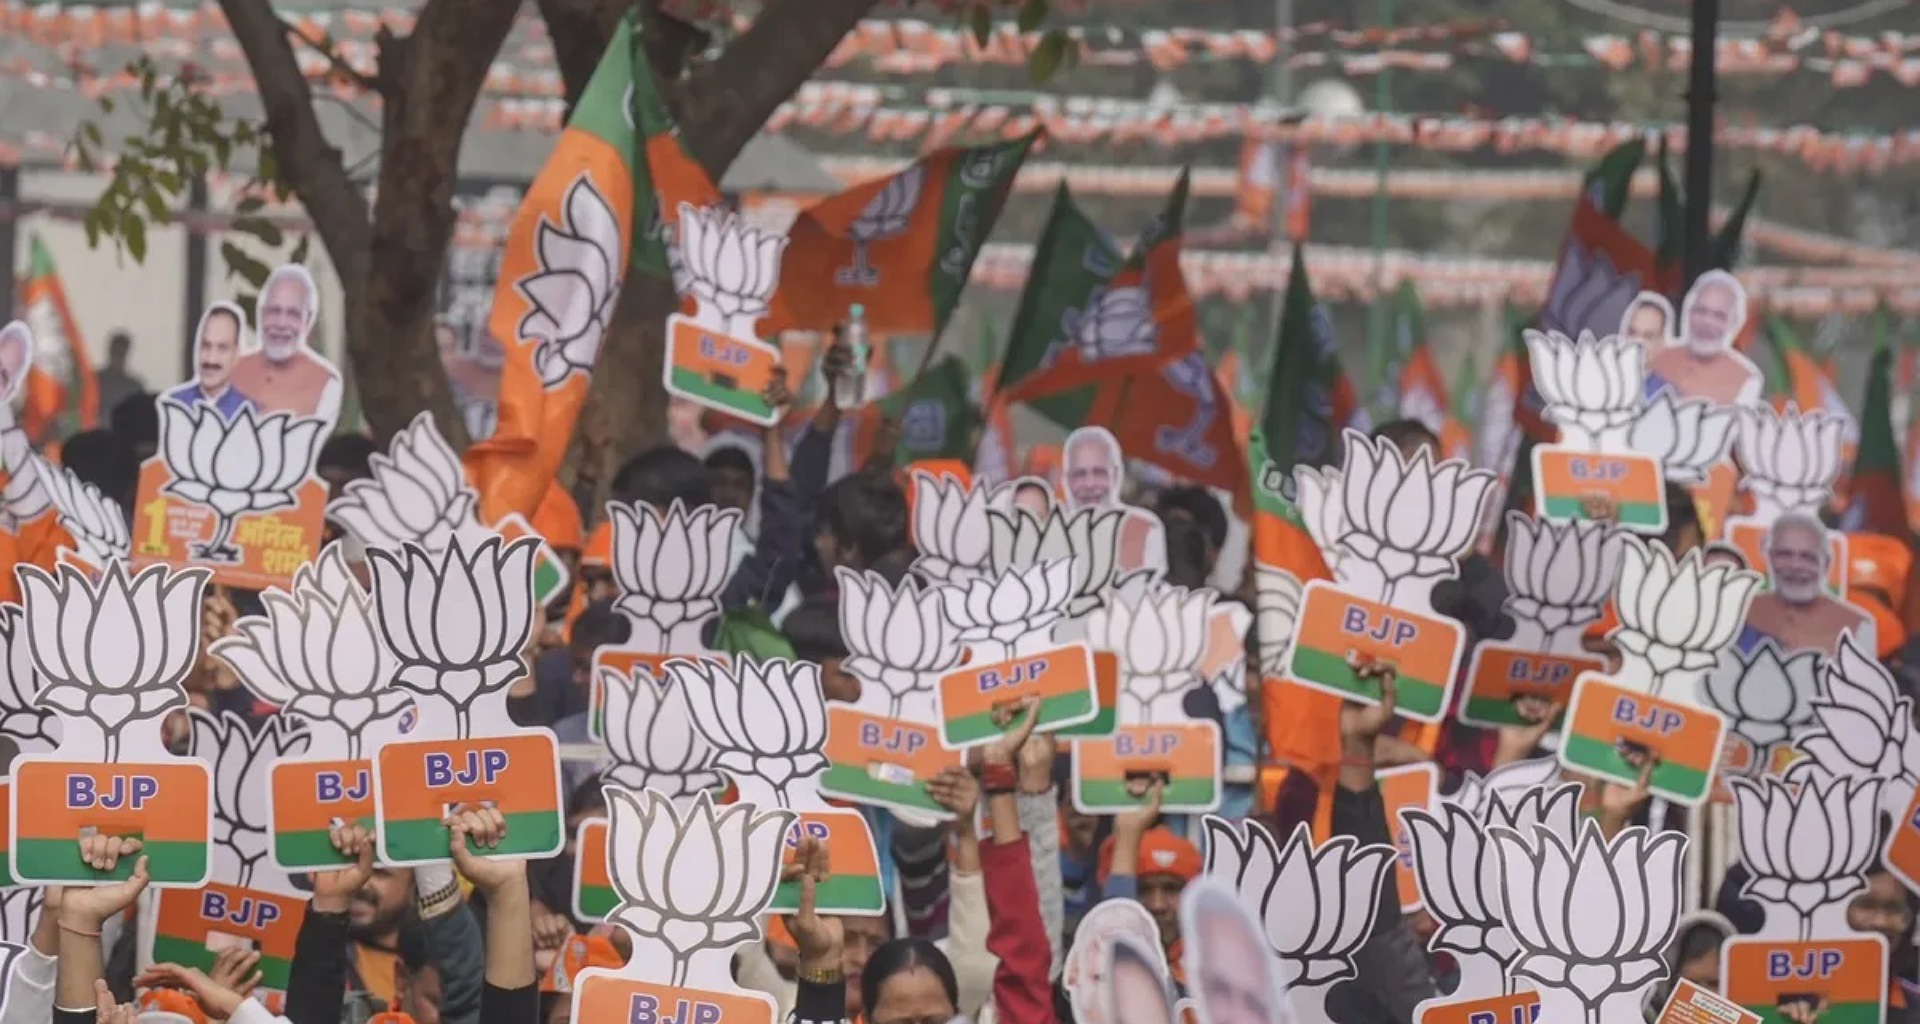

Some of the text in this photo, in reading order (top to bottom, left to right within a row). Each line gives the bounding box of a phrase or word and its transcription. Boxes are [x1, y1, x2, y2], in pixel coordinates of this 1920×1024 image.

[699, 333, 752, 365] BJP
[1570, 458, 1627, 480] BJP
[1343, 604, 1417, 648] BJP
[979, 660, 1048, 691] BJP
[1509, 658, 1571, 684] BJP
[1613, 696, 1684, 736] BJP
[860, 721, 928, 754] BJP
[1115, 733, 1178, 756] BJP
[424, 748, 509, 788] BJP
[66, 773, 158, 810] BJP
[316, 769, 369, 803] BJ
[201, 891, 280, 930] BJP
[1767, 948, 1844, 981] BJP
[628, 993, 722, 1024] BJP
